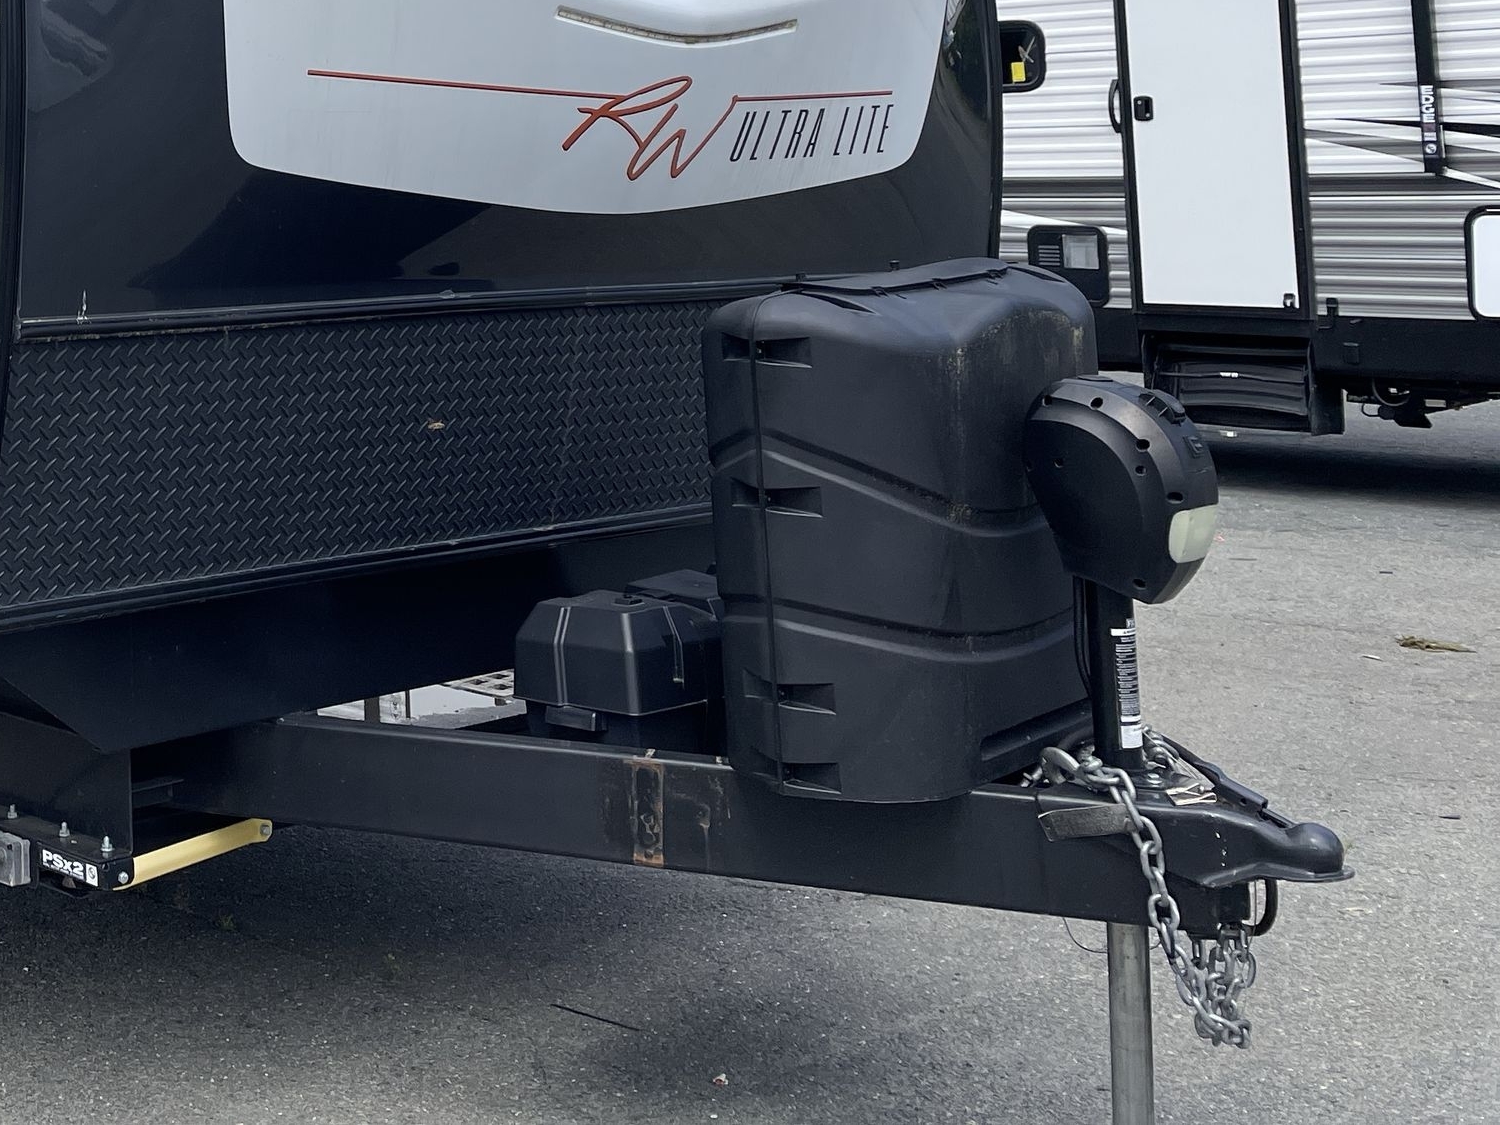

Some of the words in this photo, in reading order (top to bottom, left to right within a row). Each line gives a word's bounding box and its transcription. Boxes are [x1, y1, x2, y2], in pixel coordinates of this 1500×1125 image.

[1419, 85, 1436, 123] EDGE
[561, 75, 738, 181] RW
[729, 107, 825, 163] ULTRA
[832, 103, 895, 157] LITE
[42, 848, 85, 877] PSx2
